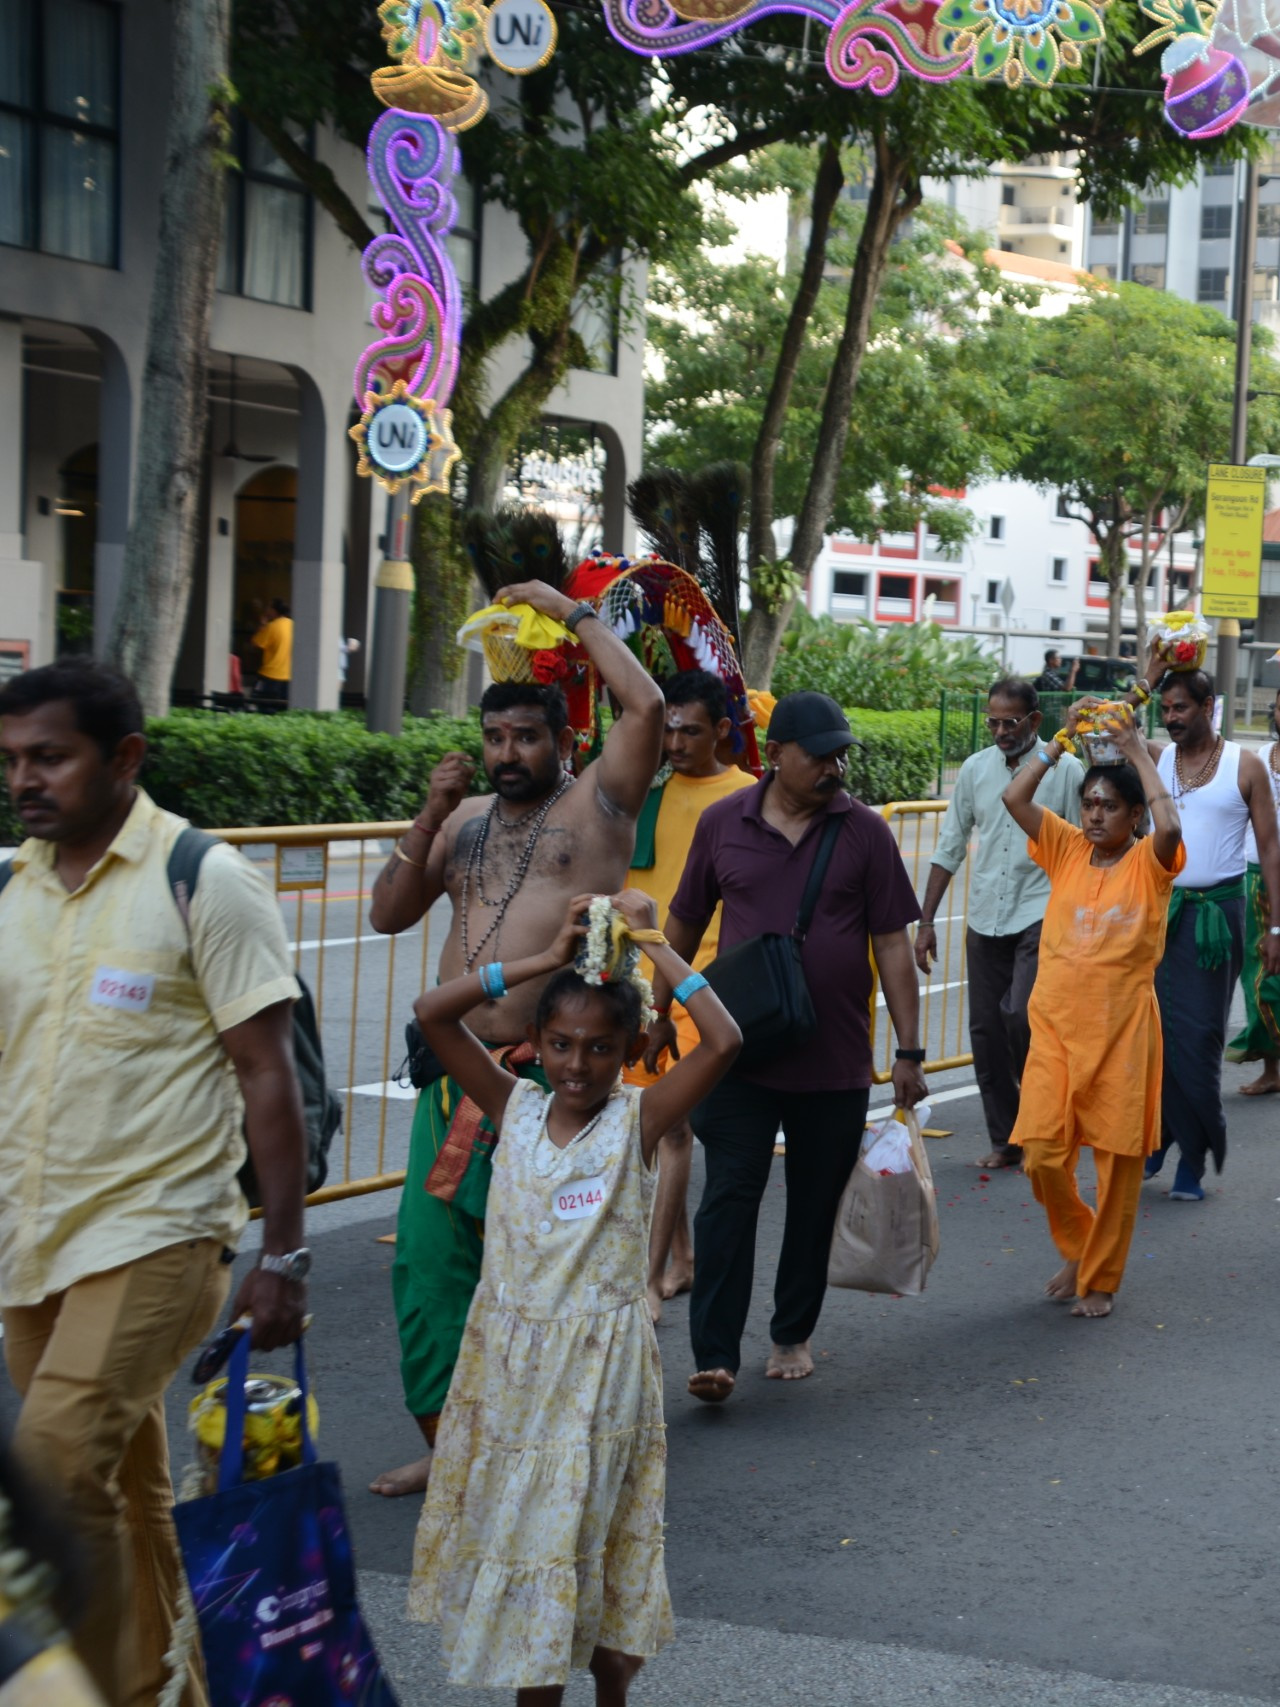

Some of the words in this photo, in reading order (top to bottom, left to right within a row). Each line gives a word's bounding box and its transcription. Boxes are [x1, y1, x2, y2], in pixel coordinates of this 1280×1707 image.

[1211, 467, 1229, 478] LANE
[1231, 468, 1264, 480] CLOSURE
[559, 1189, 602, 1210] 02144
